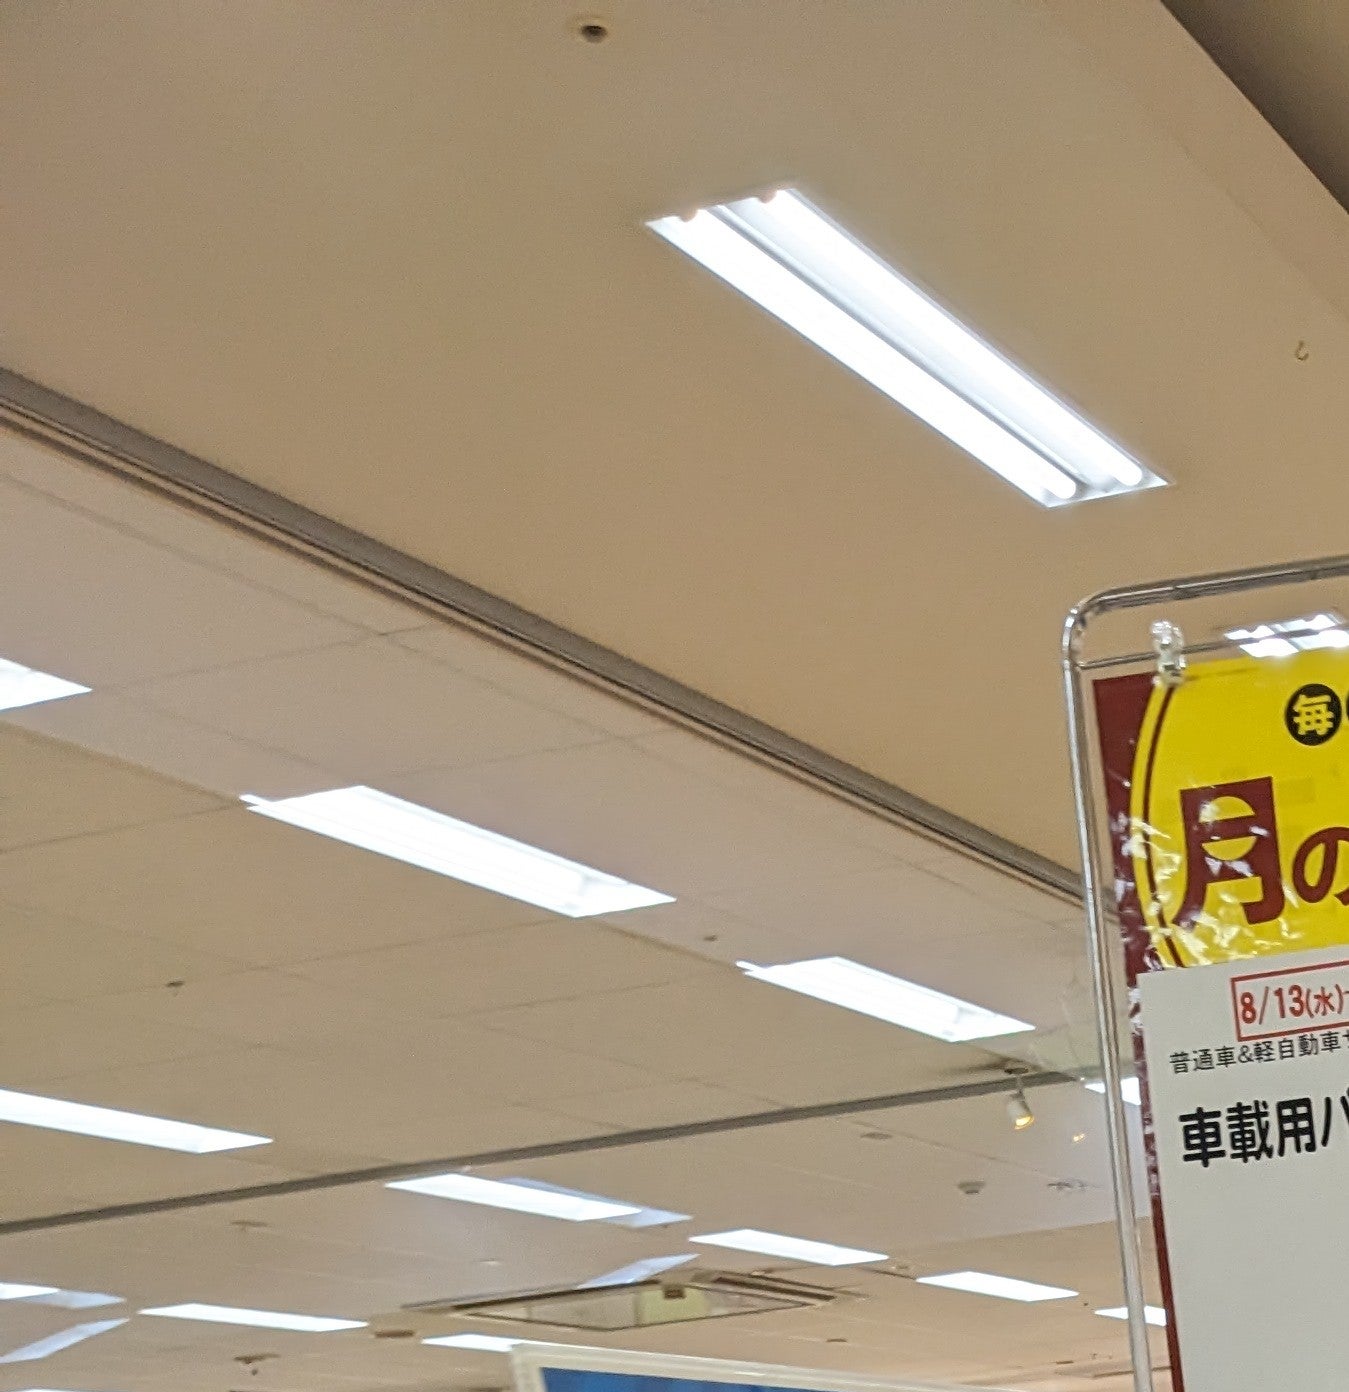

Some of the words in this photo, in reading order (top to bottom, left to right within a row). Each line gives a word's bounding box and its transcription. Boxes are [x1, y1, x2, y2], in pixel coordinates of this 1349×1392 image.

[1293, 694, 1334, 735] 毎
[1171, 776, 1349, 926] 月の
[1240, 983, 1349, 1025] 8/13(水)
[1169, 1029, 1349, 1074] 普通車&軽自動車
